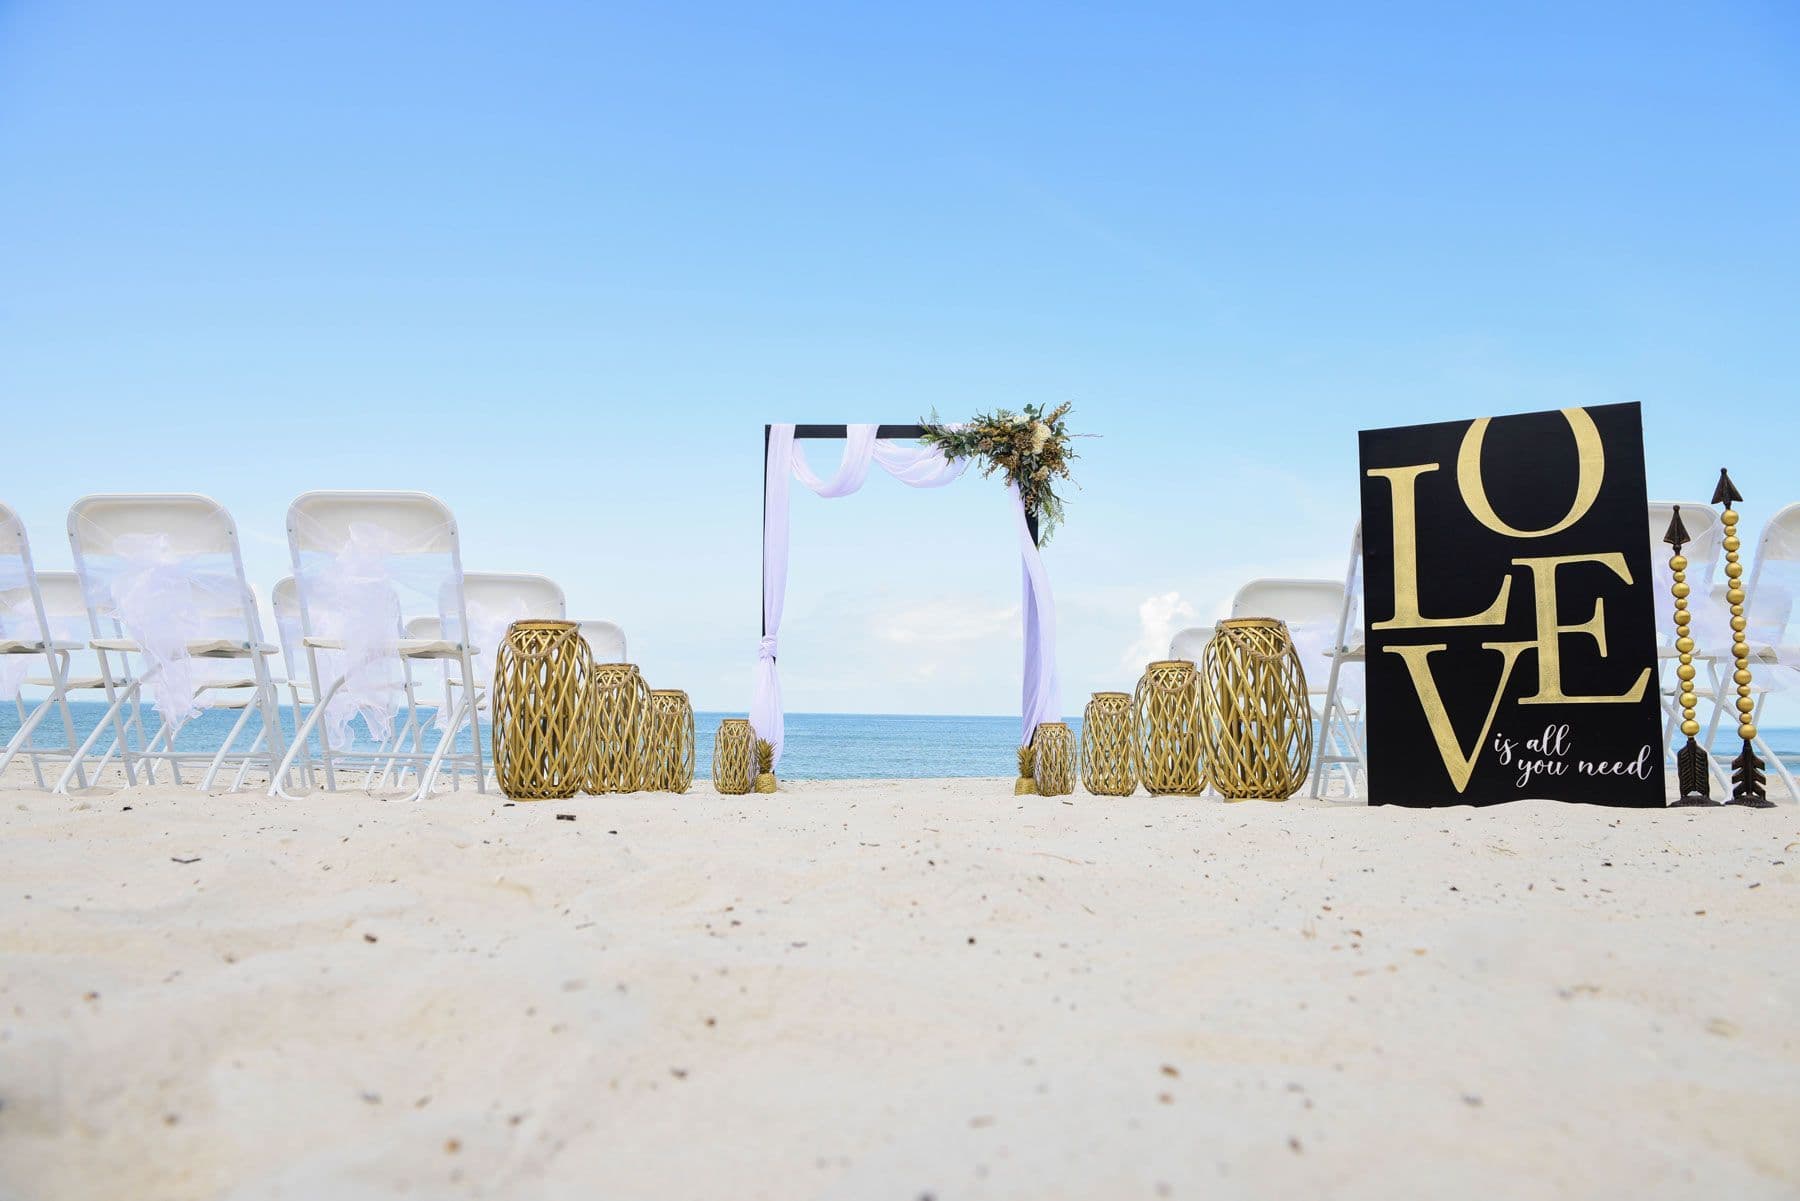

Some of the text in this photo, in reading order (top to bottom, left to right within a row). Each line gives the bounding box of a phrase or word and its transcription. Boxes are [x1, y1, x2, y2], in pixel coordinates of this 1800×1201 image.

[1494, 723, 1572, 766] is all
[1515, 744, 1653, 788] you need
